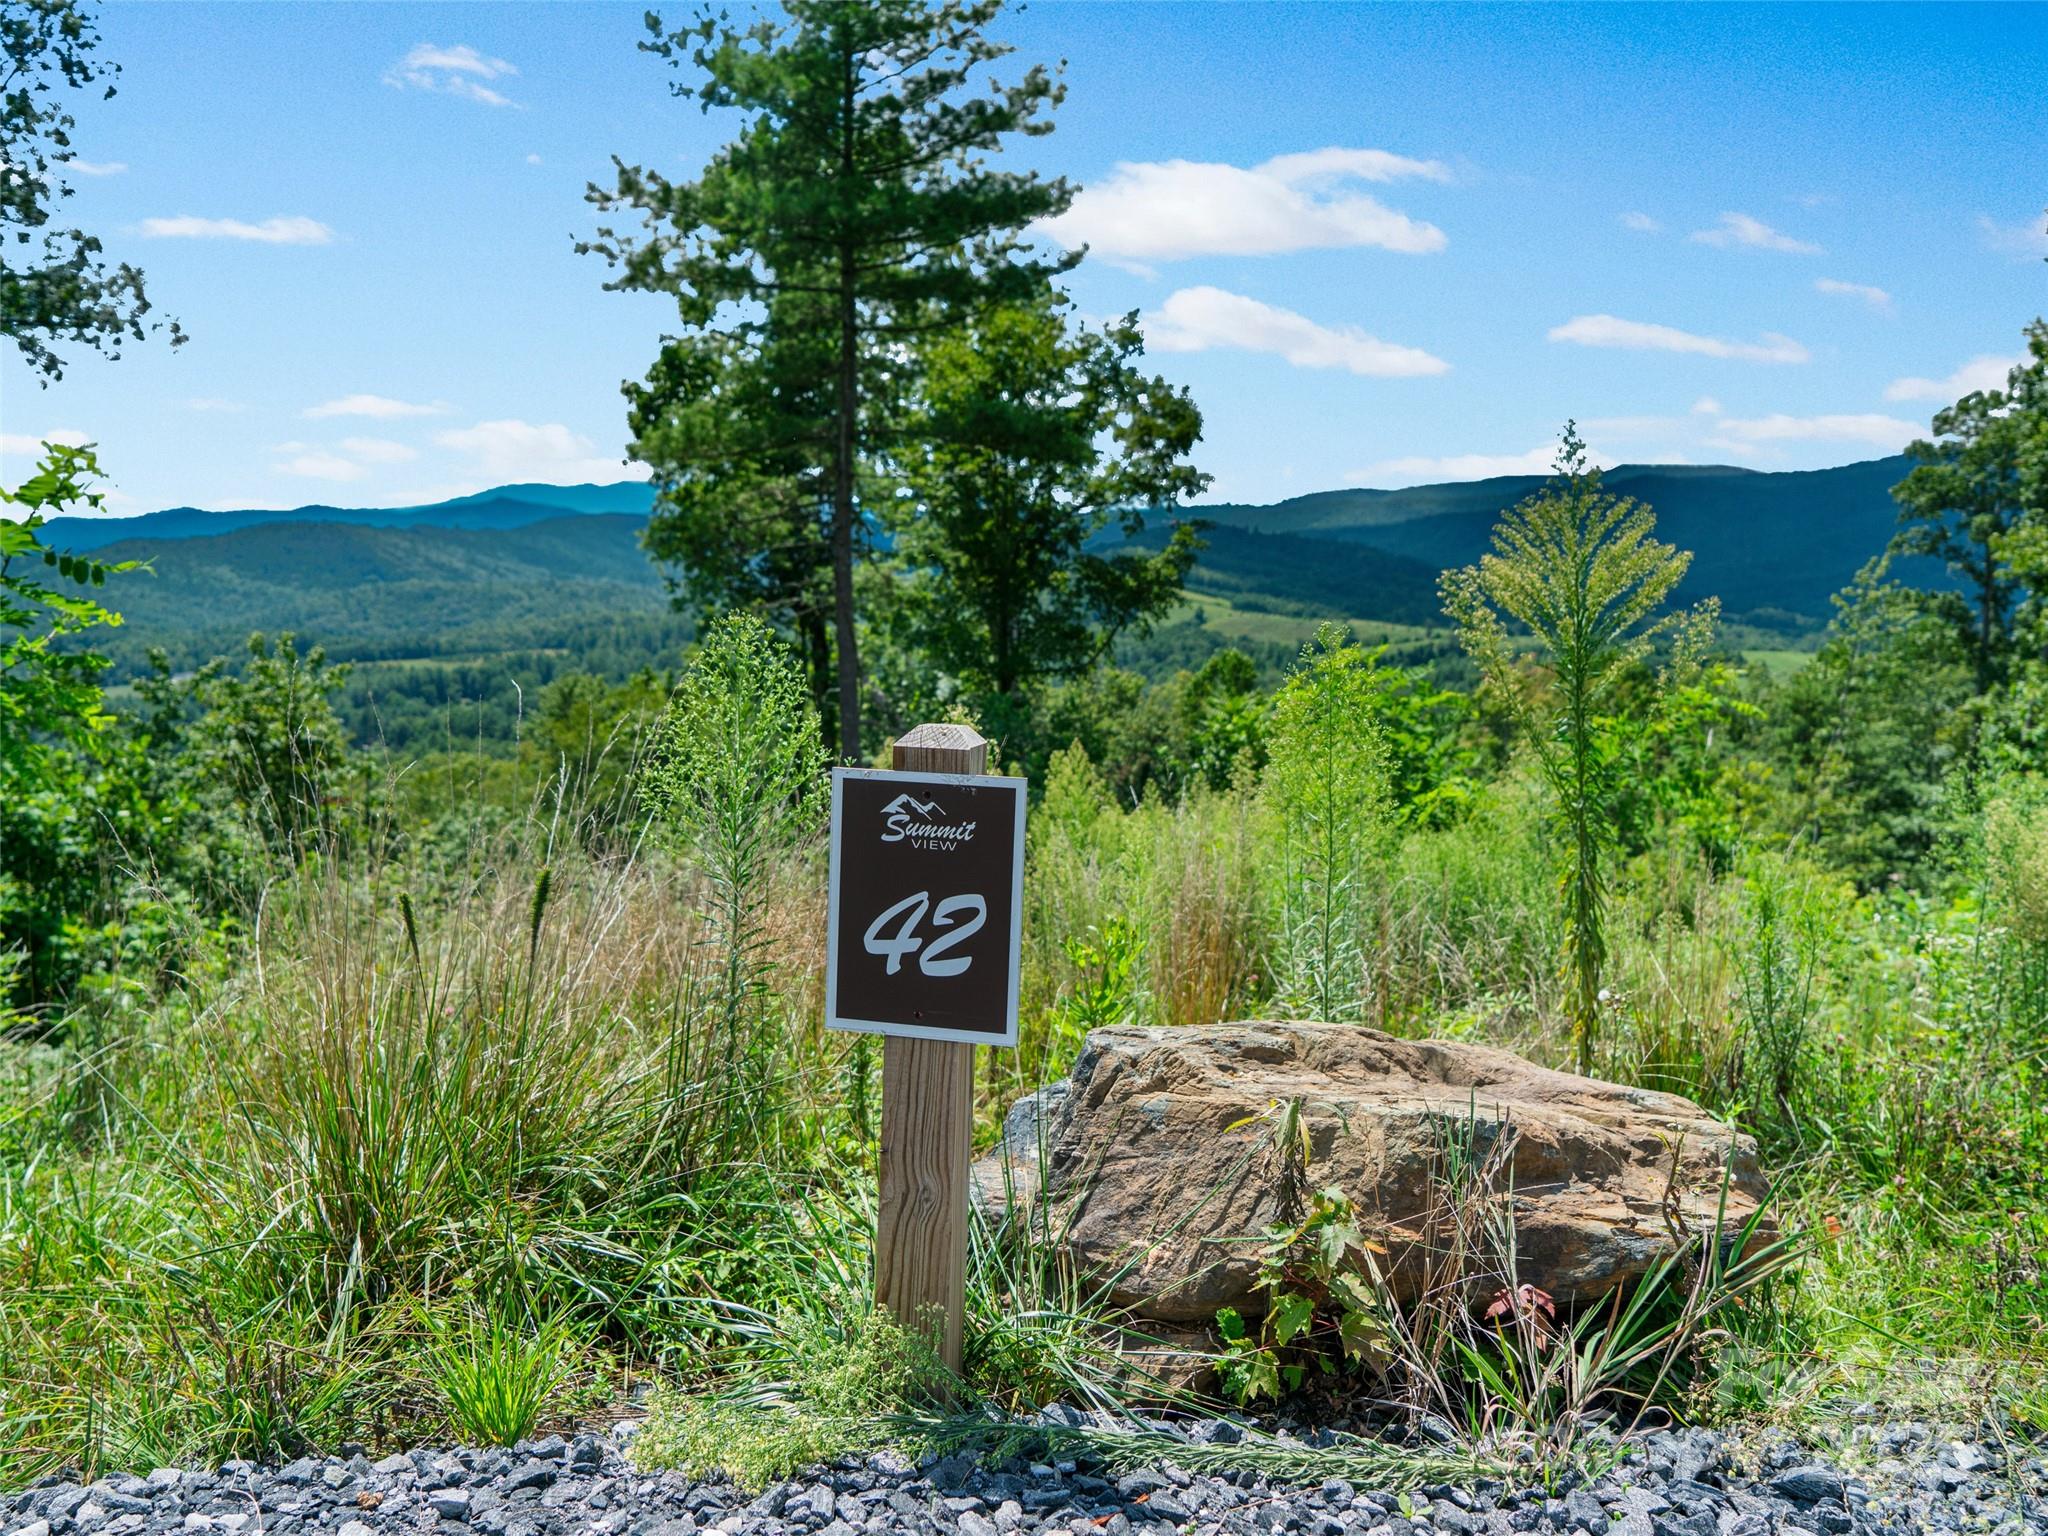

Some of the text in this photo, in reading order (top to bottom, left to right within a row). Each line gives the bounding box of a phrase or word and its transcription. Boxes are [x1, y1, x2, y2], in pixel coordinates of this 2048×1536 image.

[880, 814, 977, 842] Summit
[911, 838, 958, 851] VIEW
[863, 891, 987, 977] 42
